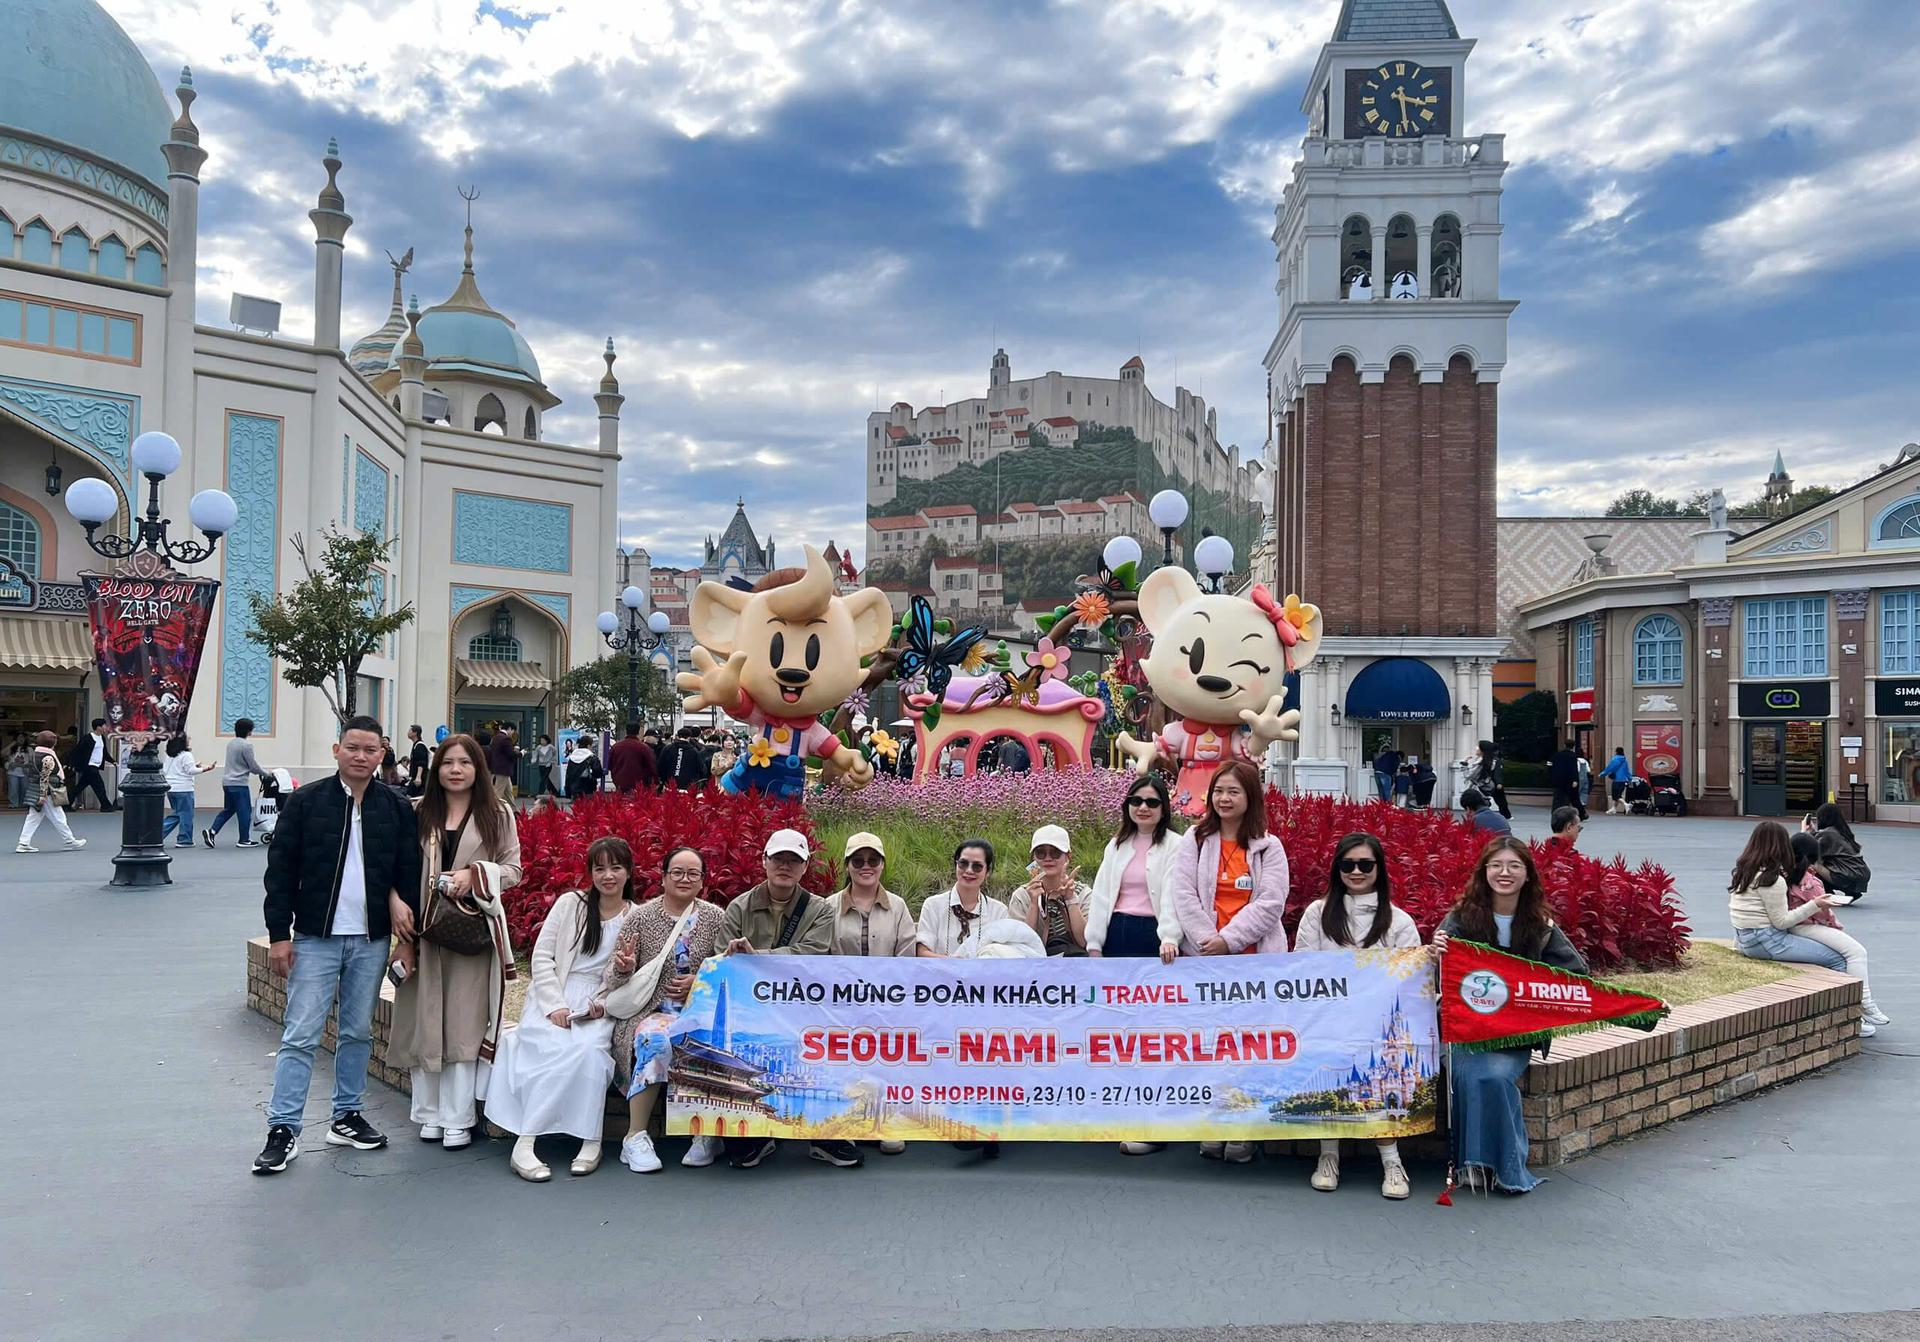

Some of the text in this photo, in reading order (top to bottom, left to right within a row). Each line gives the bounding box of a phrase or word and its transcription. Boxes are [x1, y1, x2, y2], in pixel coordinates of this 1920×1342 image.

[97, 579, 155, 599] BLOOD
[118, 599, 172, 620] ZERO
[1772, 694, 1794, 704] CU
[260, 805, 277, 814] NIK
[753, 977, 1348, 1004] CHÀO MỪNG ĐOÀN KHÁCH J TRAVEL THAM QUAN
[1514, 981, 1592, 1001] J TRAVEL
[802, 1030, 928, 1063] SEOUL
[959, 1030, 1056, 1063] NAMI
[1089, 1030, 1297, 1063] EVERLAND
[886, 1085, 913, 1104] NO
[1102, 1084, 1212, 1104] 27/10/2026
